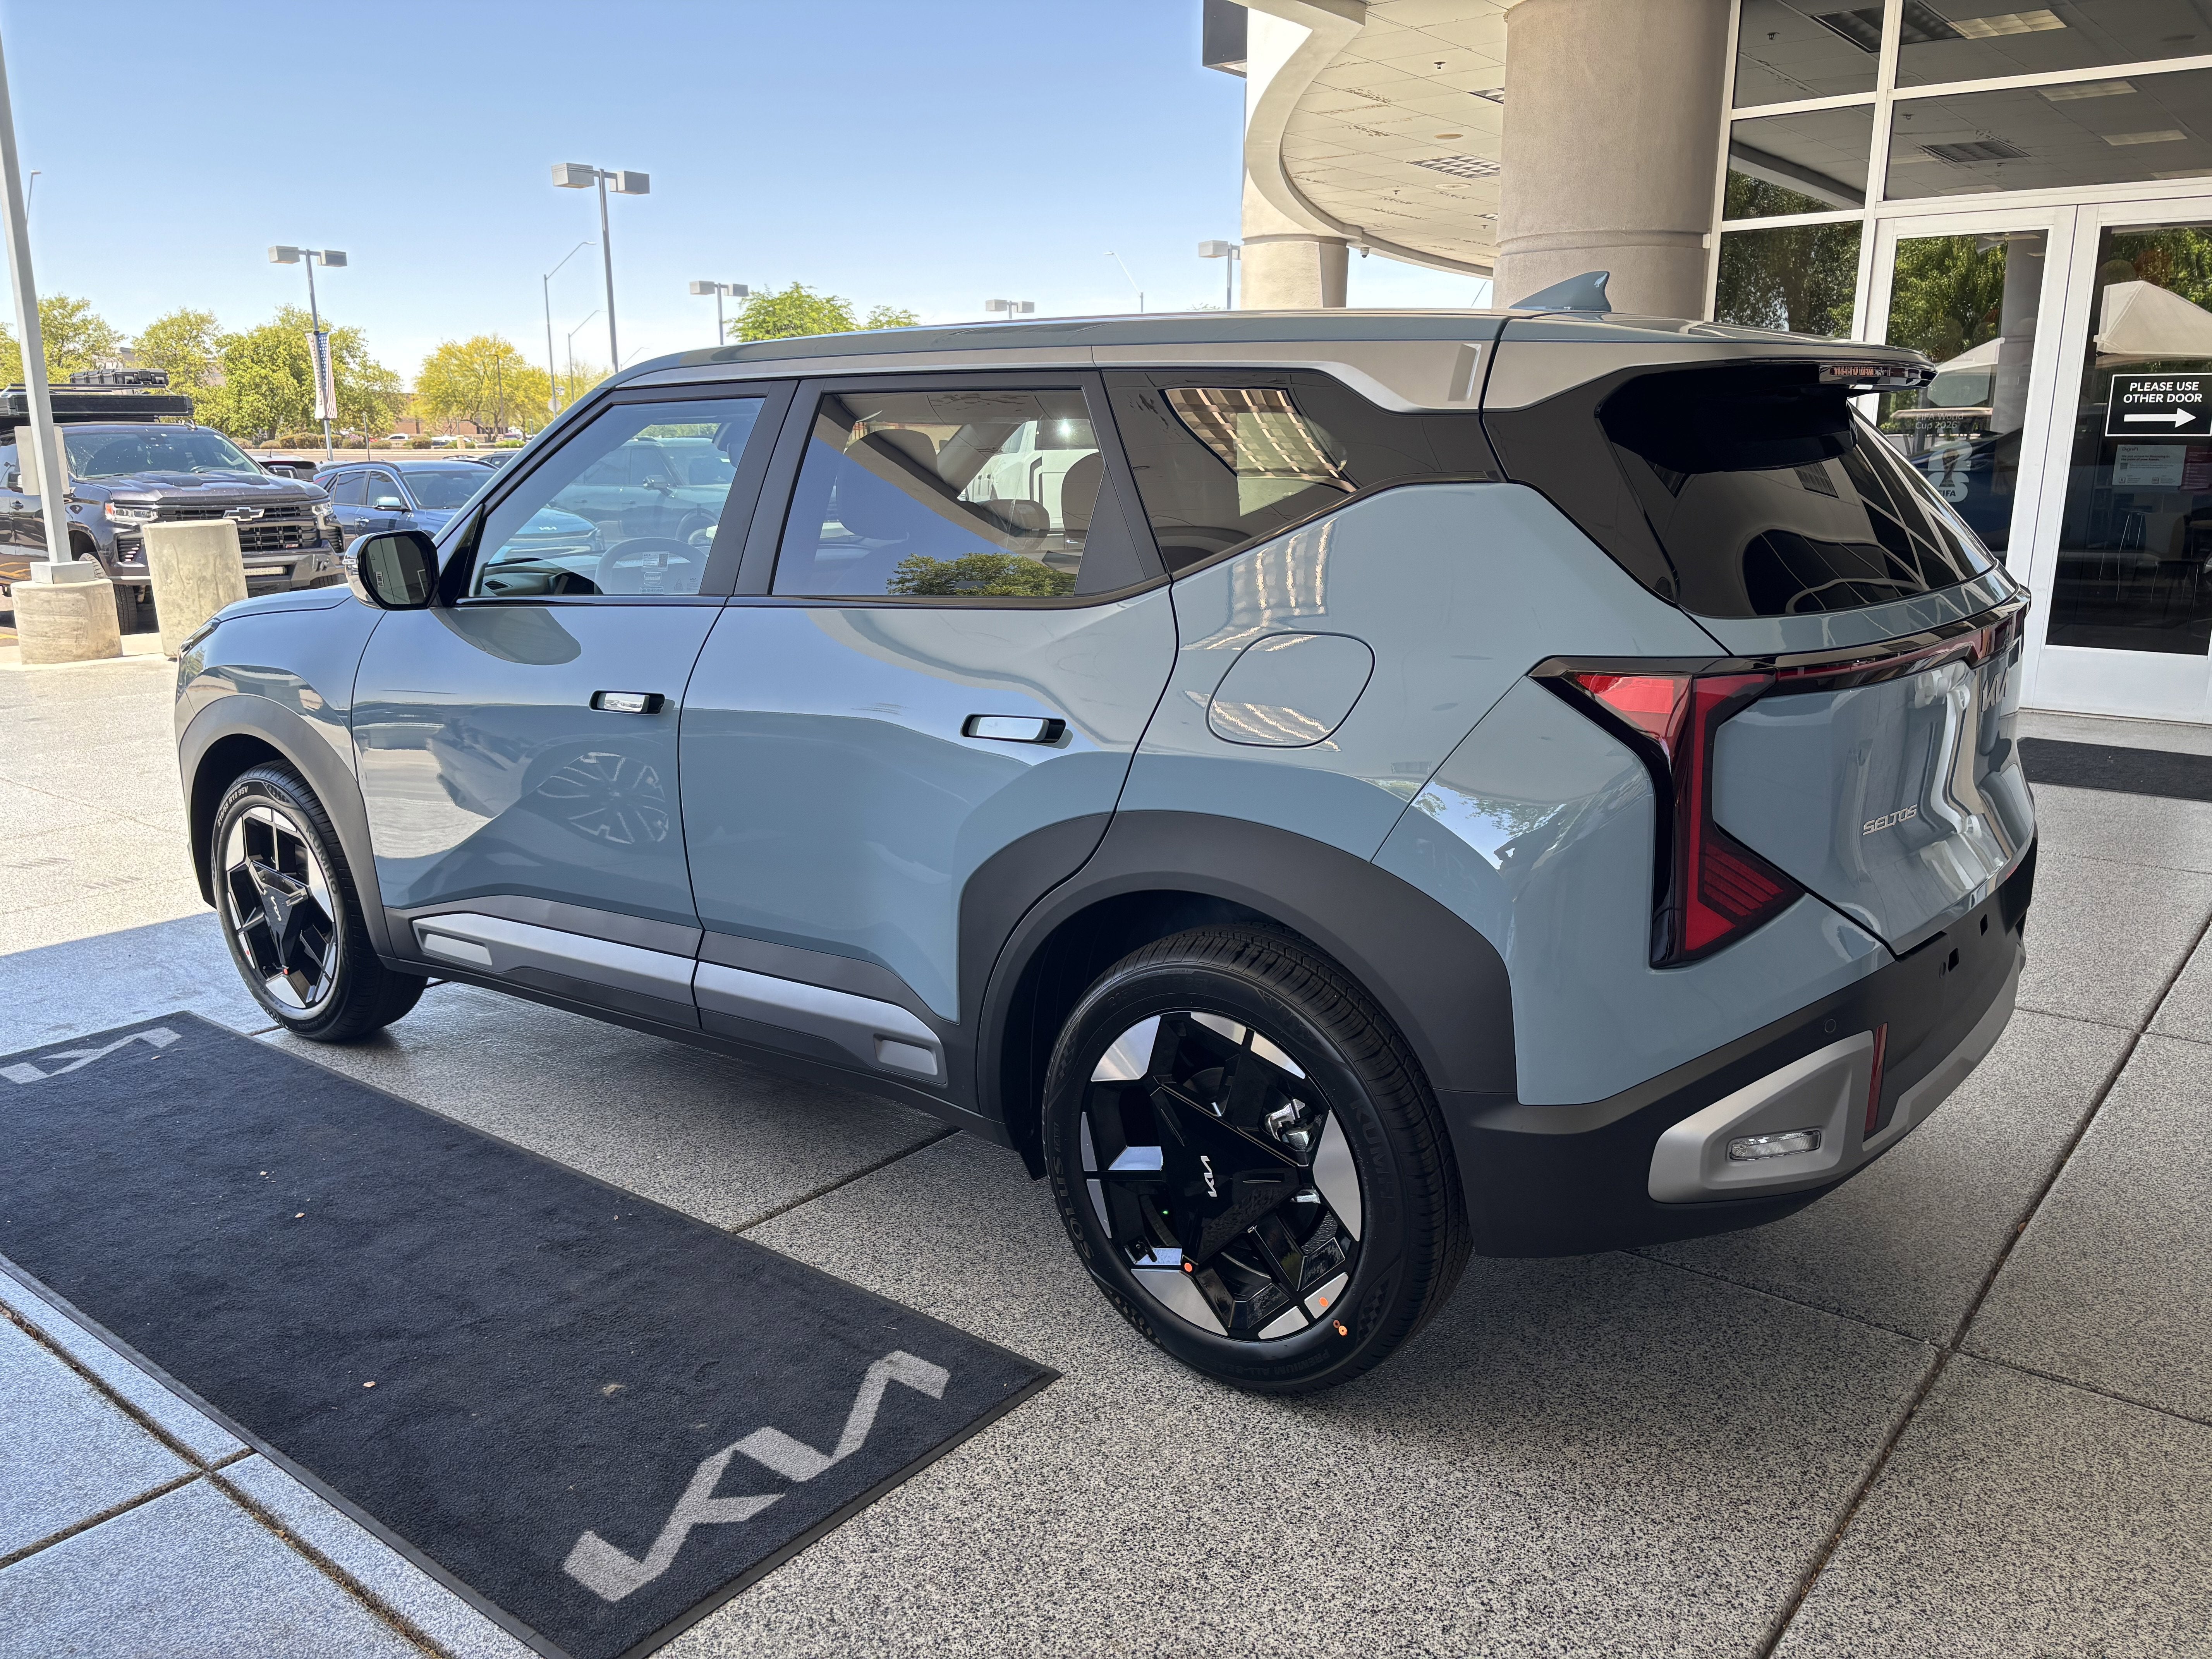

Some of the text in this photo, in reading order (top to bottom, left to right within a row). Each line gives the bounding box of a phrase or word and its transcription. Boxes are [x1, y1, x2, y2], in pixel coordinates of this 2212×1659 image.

[2123, 393, 2203, 403] OTHER DOOR
[2130, 381, 2200, 392] PLEASE USE
[1916, 421, 1933, 431] Cup
[1863, 804, 1917, 835] SELTOS
[306, 824, 338, 895] KUMHO
[1200, 1156, 1217, 1197] KIA
[1349, 1098, 1397, 1225] KUMHO
[1053, 1156, 1095, 1260] SOLUS
[563, 1350, 951, 1602] KIA
